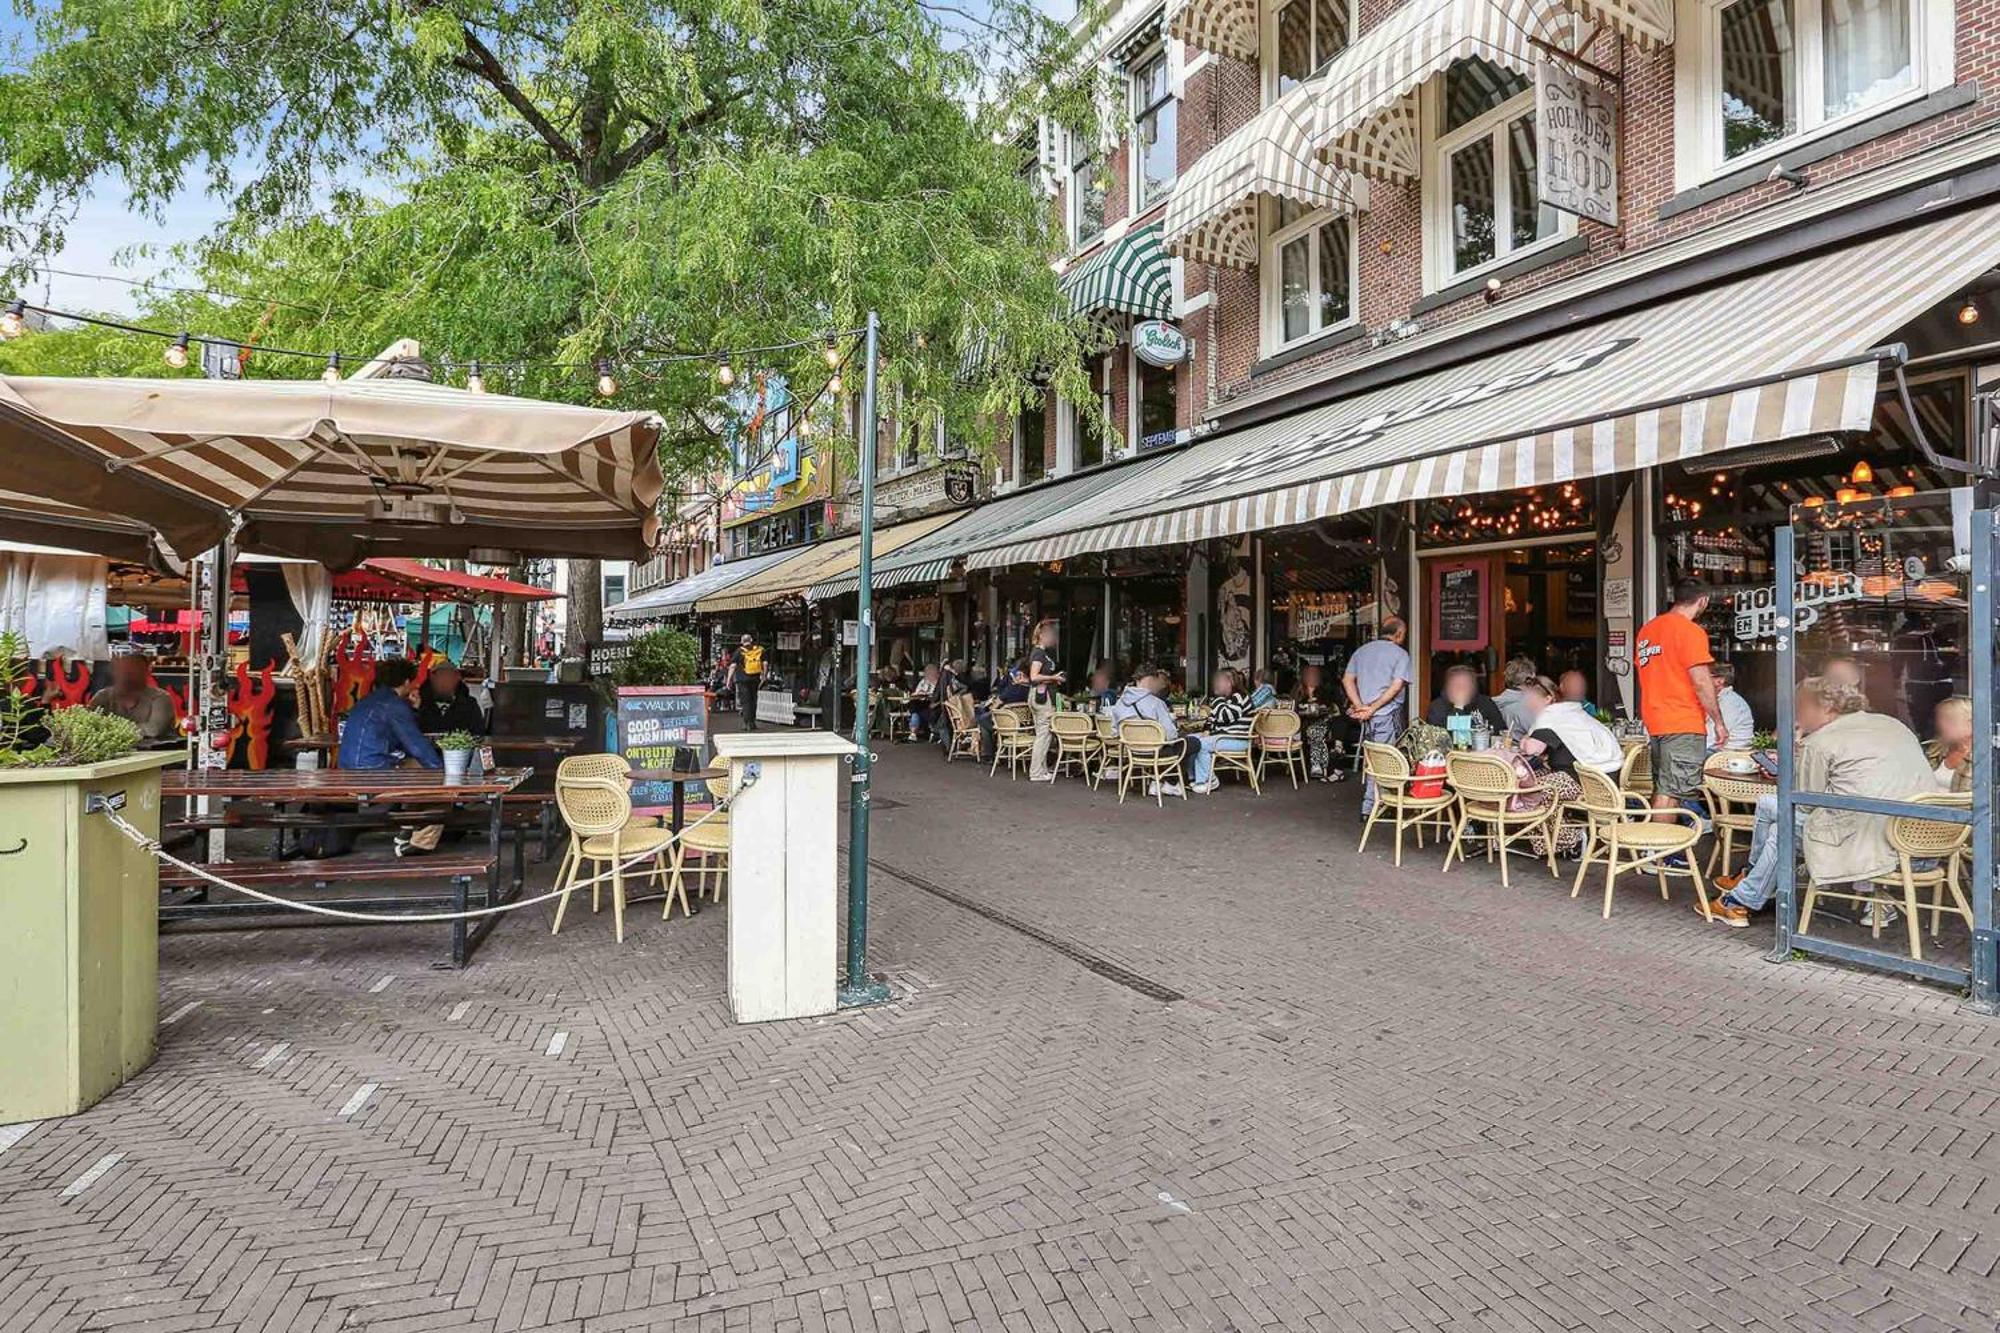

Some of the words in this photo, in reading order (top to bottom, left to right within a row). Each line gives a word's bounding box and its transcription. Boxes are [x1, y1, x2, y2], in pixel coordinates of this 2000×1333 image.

[1546, 106, 1611, 155] HOENDER
[1547, 136, 1612, 195] HOP
[1145, 328, 1182, 350] Grolsch
[1736, 616, 1753, 636] EN
[1758, 606, 1813, 633] HP
[642, 700, 674, 711] WALK
[676, 700, 690, 711] IN
[628, 719, 659, 733] GOOD
[628, 727, 686, 746] MORNING!
